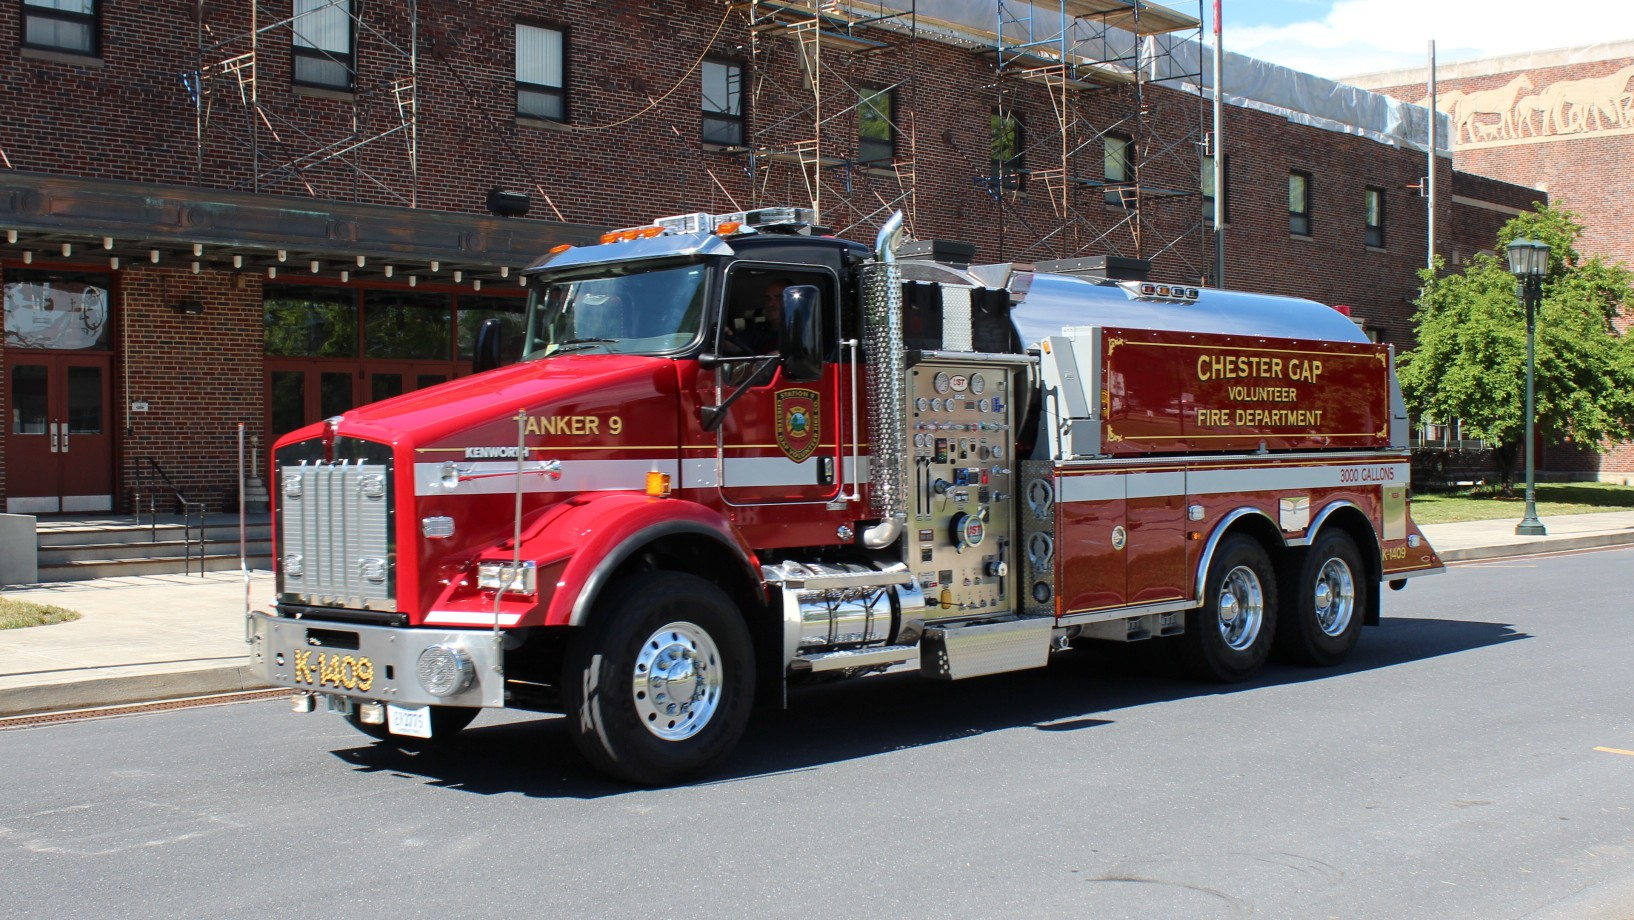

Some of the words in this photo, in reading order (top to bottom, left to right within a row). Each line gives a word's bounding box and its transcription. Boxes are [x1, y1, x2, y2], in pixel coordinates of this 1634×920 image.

[1197, 355, 1282, 381] CHESTER
[1288, 359, 1322, 383] GAP
[780, 391, 809, 399] STATION
[1228, 386, 1297, 401] VOLUNTEER
[608, 416, 623, 435] 9
[1197, 410, 1230, 426] FIRE
[1236, 410, 1322, 426] DEPARTMENT
[464, 447, 530, 458] KENWORTH
[1340, 469, 1359, 482] 3000
[1361, 467, 1394, 481] GALLONS
[1382, 547, 1406, 560] K-1409
[295, 649, 374, 692] K-1409
